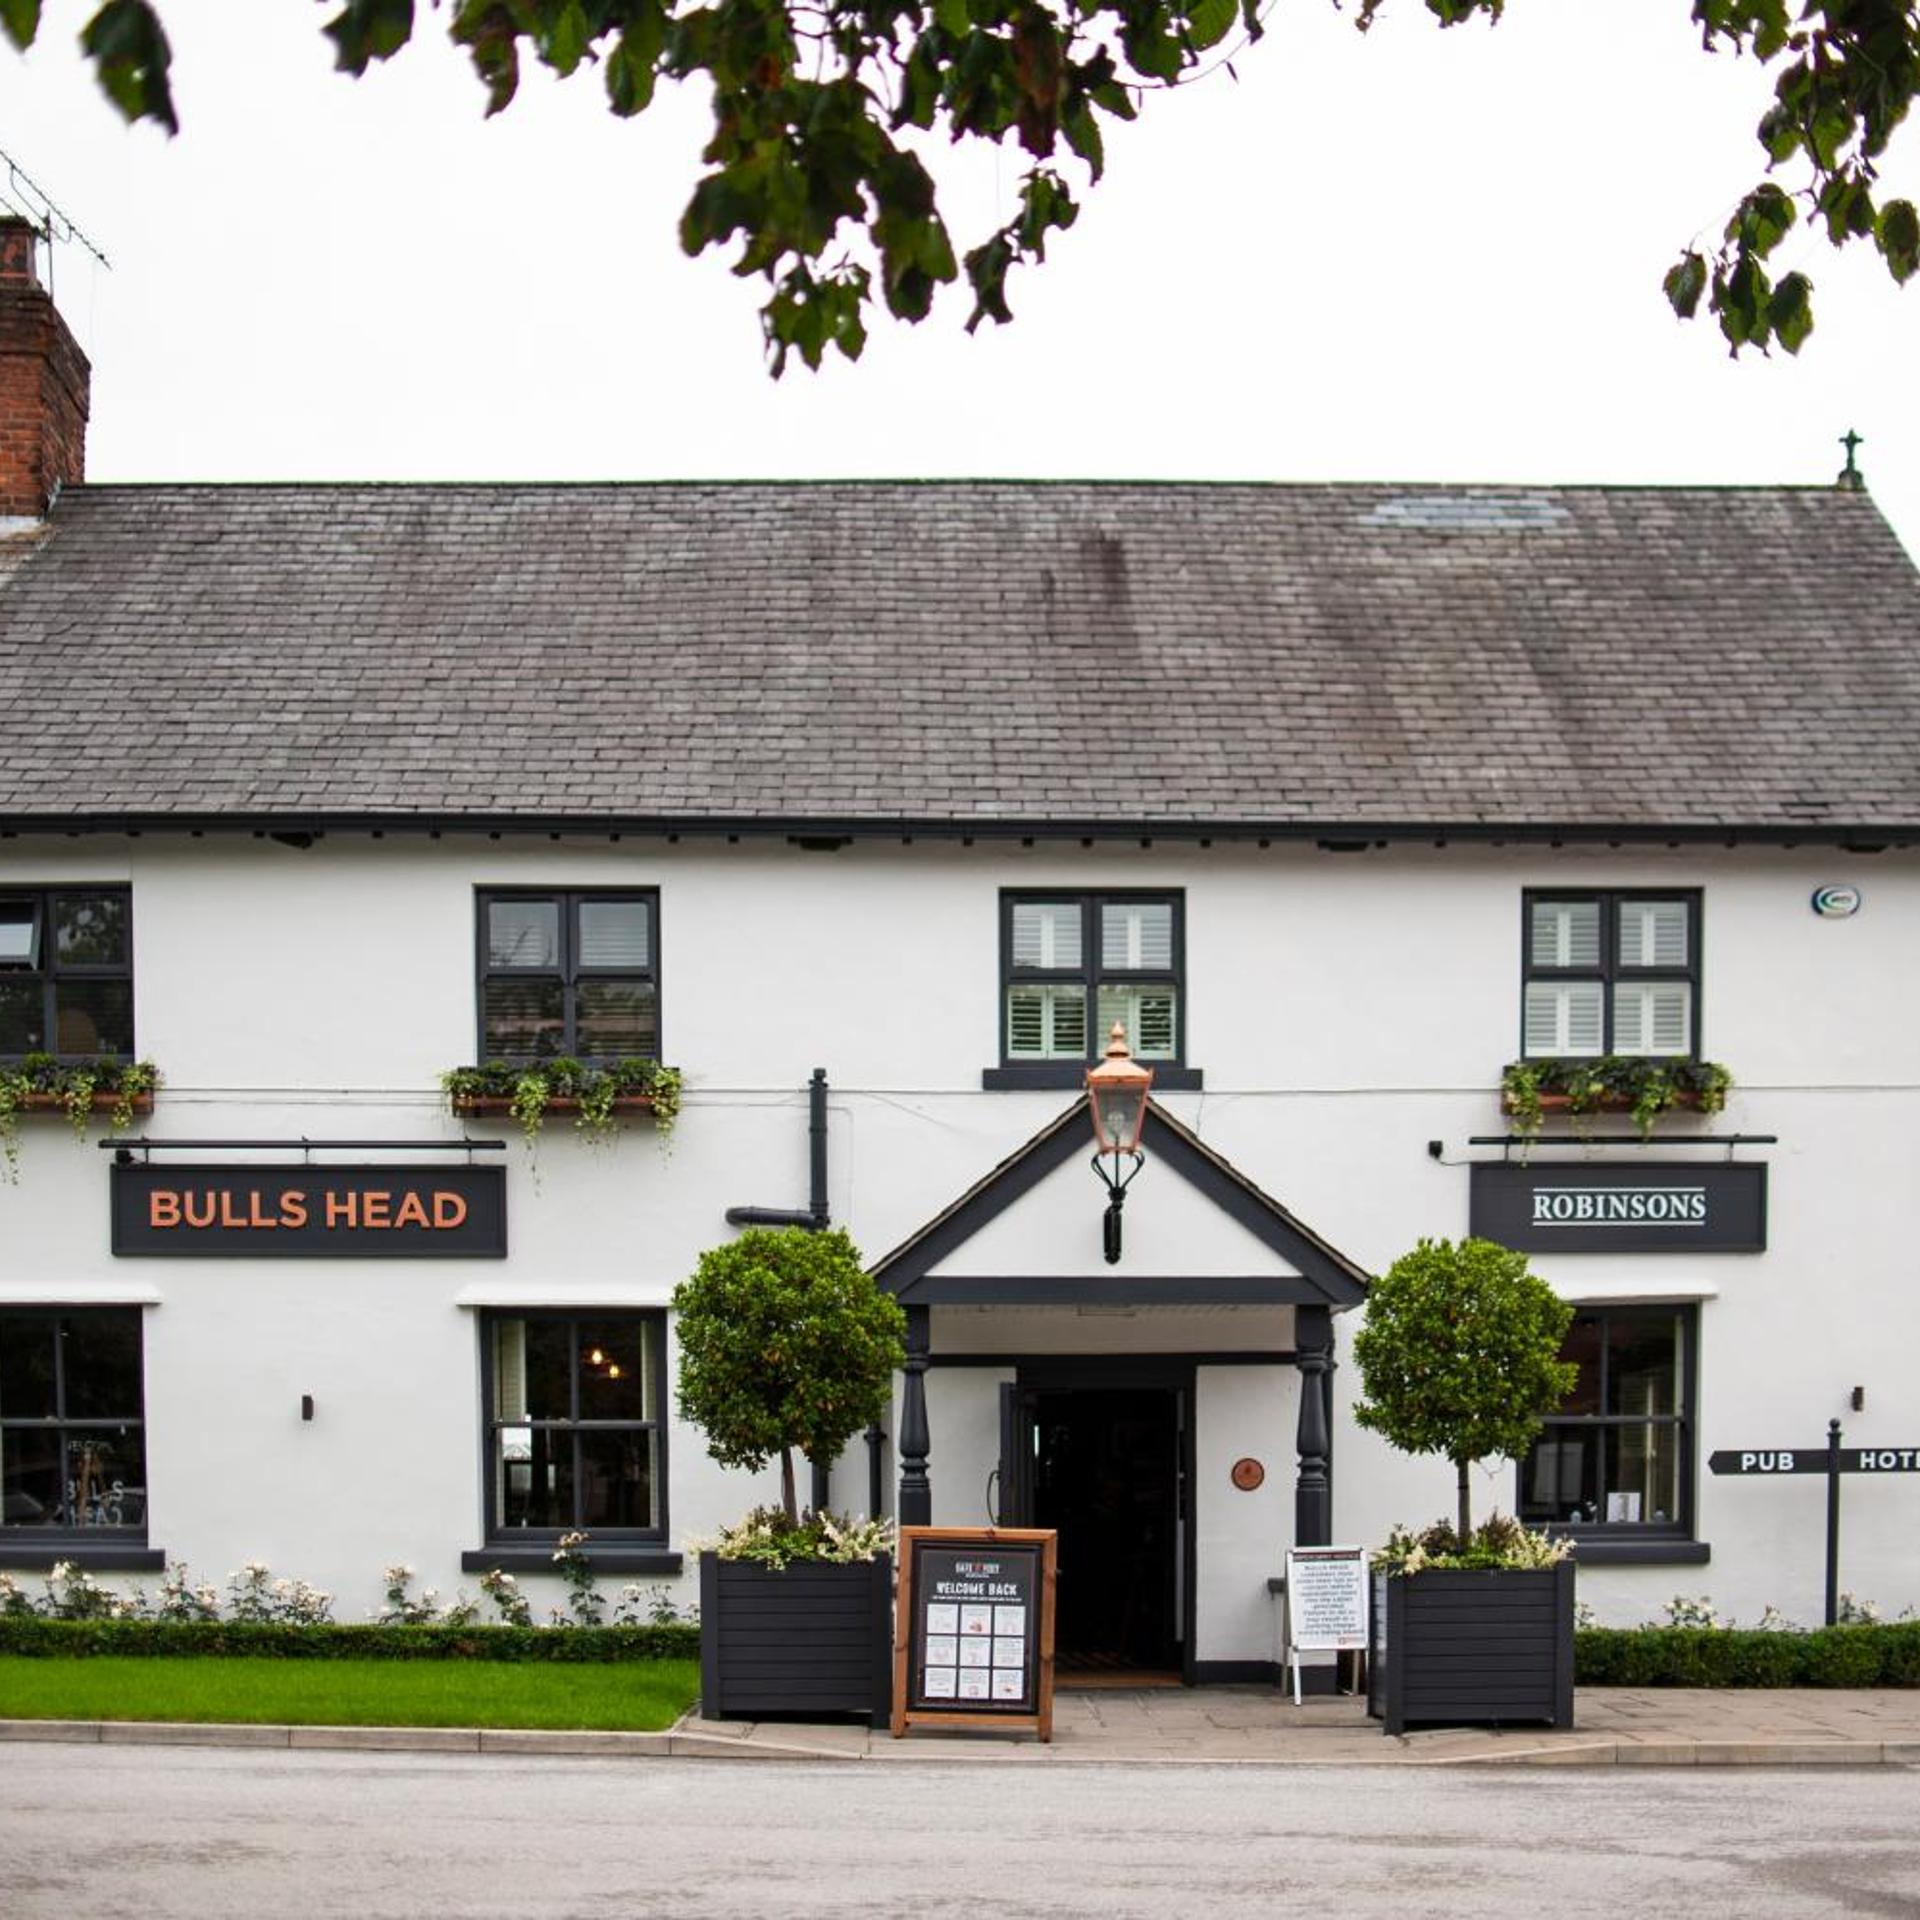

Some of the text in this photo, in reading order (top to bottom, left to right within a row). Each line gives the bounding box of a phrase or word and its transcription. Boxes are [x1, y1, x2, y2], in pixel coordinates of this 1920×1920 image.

[149, 1190, 467, 1228] BULLS HEAD
[1532, 1194, 1706, 1219] ROBINSONS
[1741, 1453, 1794, 1471] PUB
[936, 1582, 1018, 1596] WELCOME BACK
